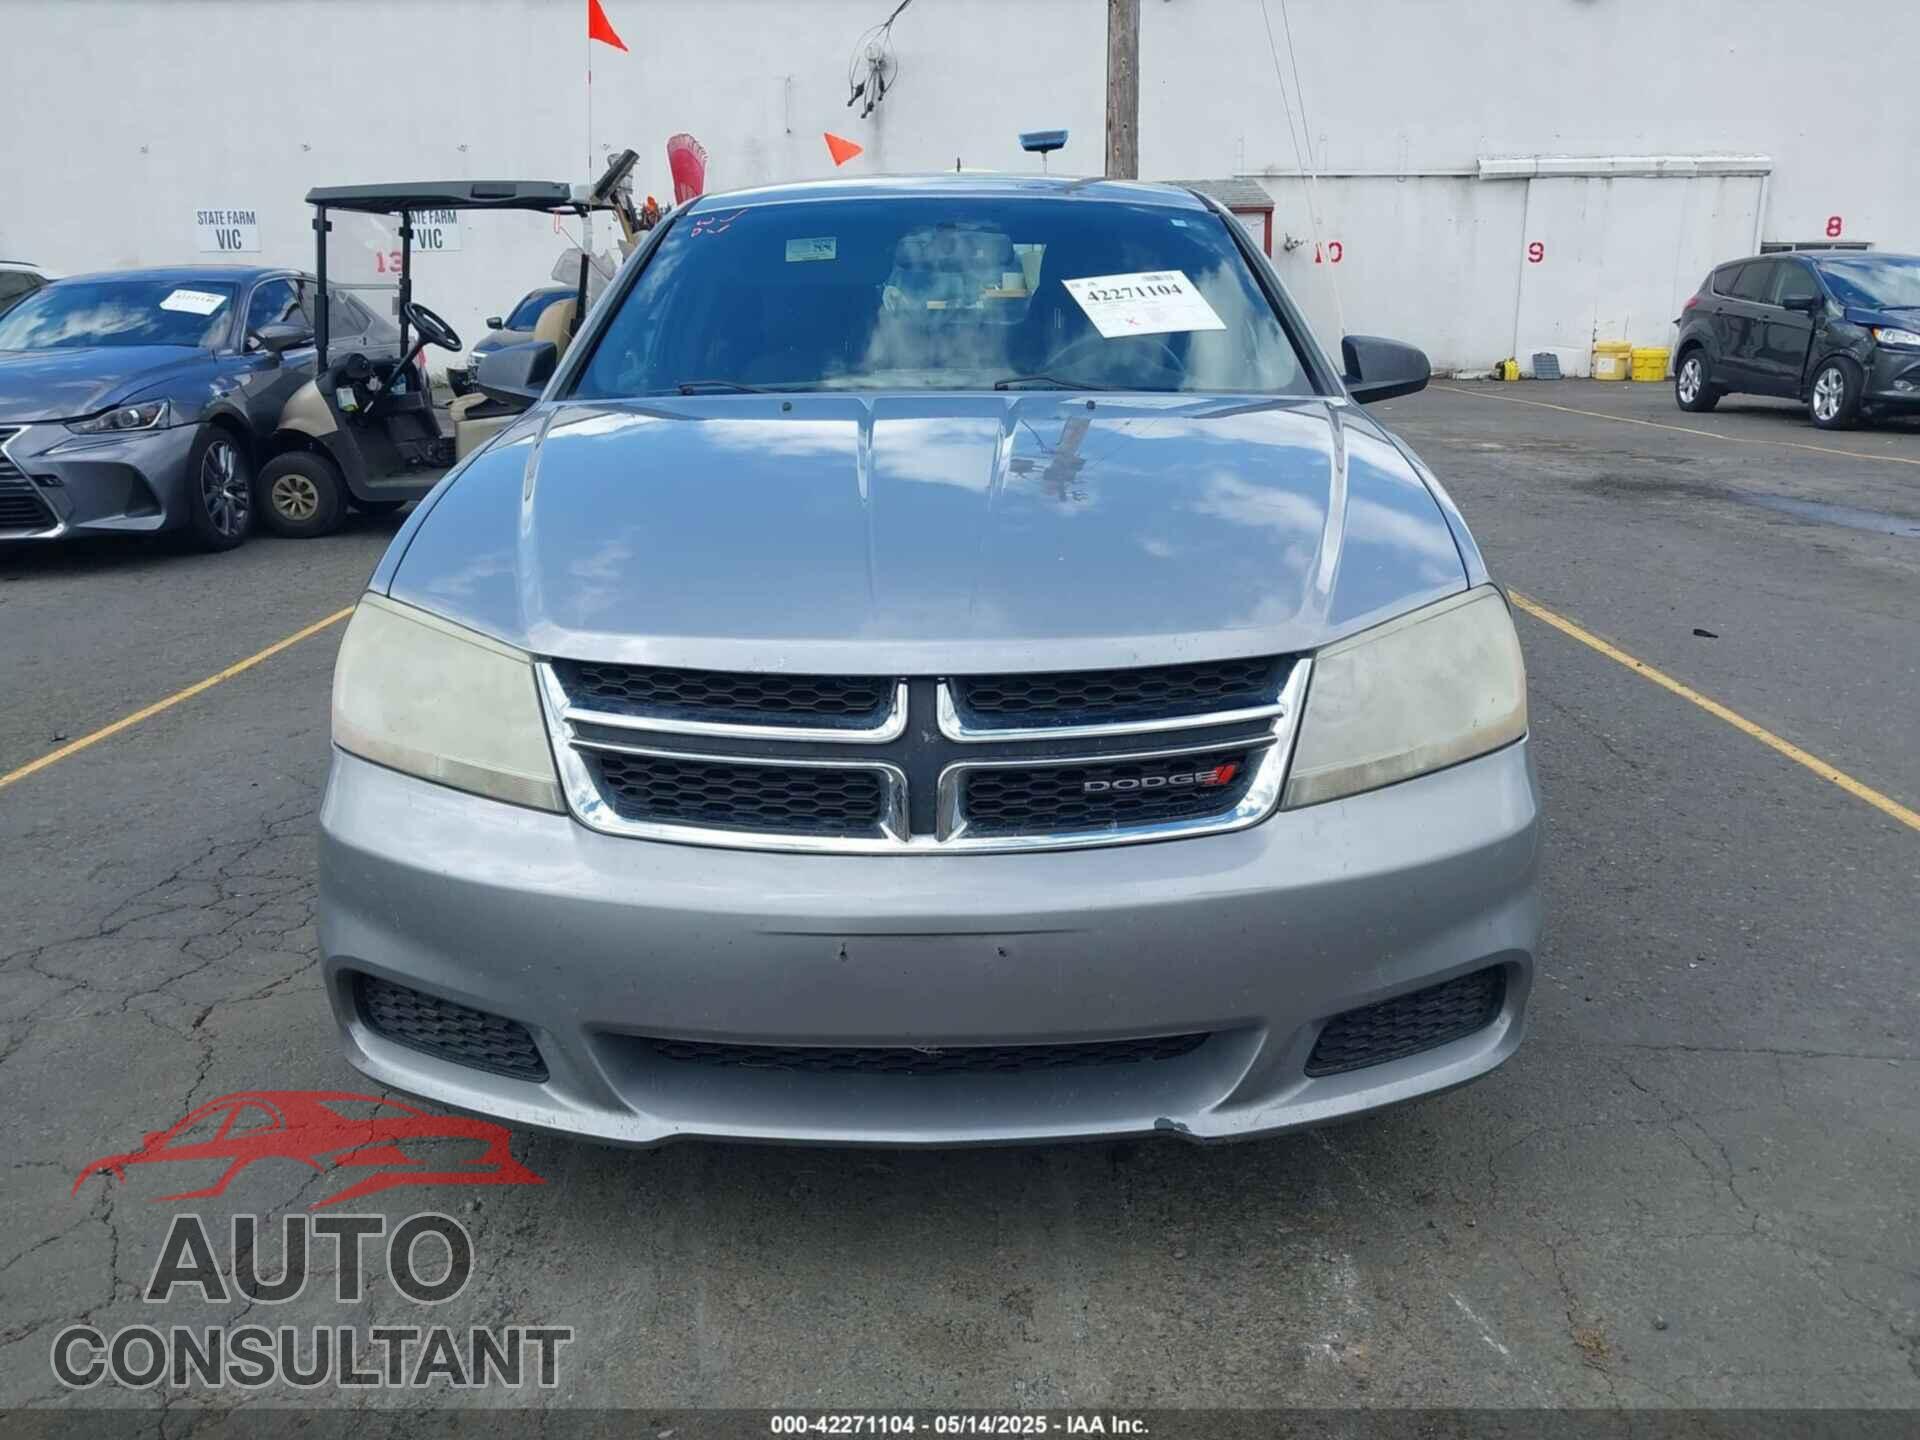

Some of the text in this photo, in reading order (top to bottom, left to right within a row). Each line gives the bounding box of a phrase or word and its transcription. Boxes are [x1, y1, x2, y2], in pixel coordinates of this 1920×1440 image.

[197, 210, 256, 225] STATE FARM
[429, 210, 458, 225] FARM
[1826, 216, 1842, 238] 8
[215, 228, 242, 250] VIC
[416, 228, 443, 249] VIC
[376, 250, 403, 273] 13
[1527, 241, 1544, 263] 9
[1088, 283, 1183, 302] 42271104
[1084, 770, 1217, 792] DODGE
